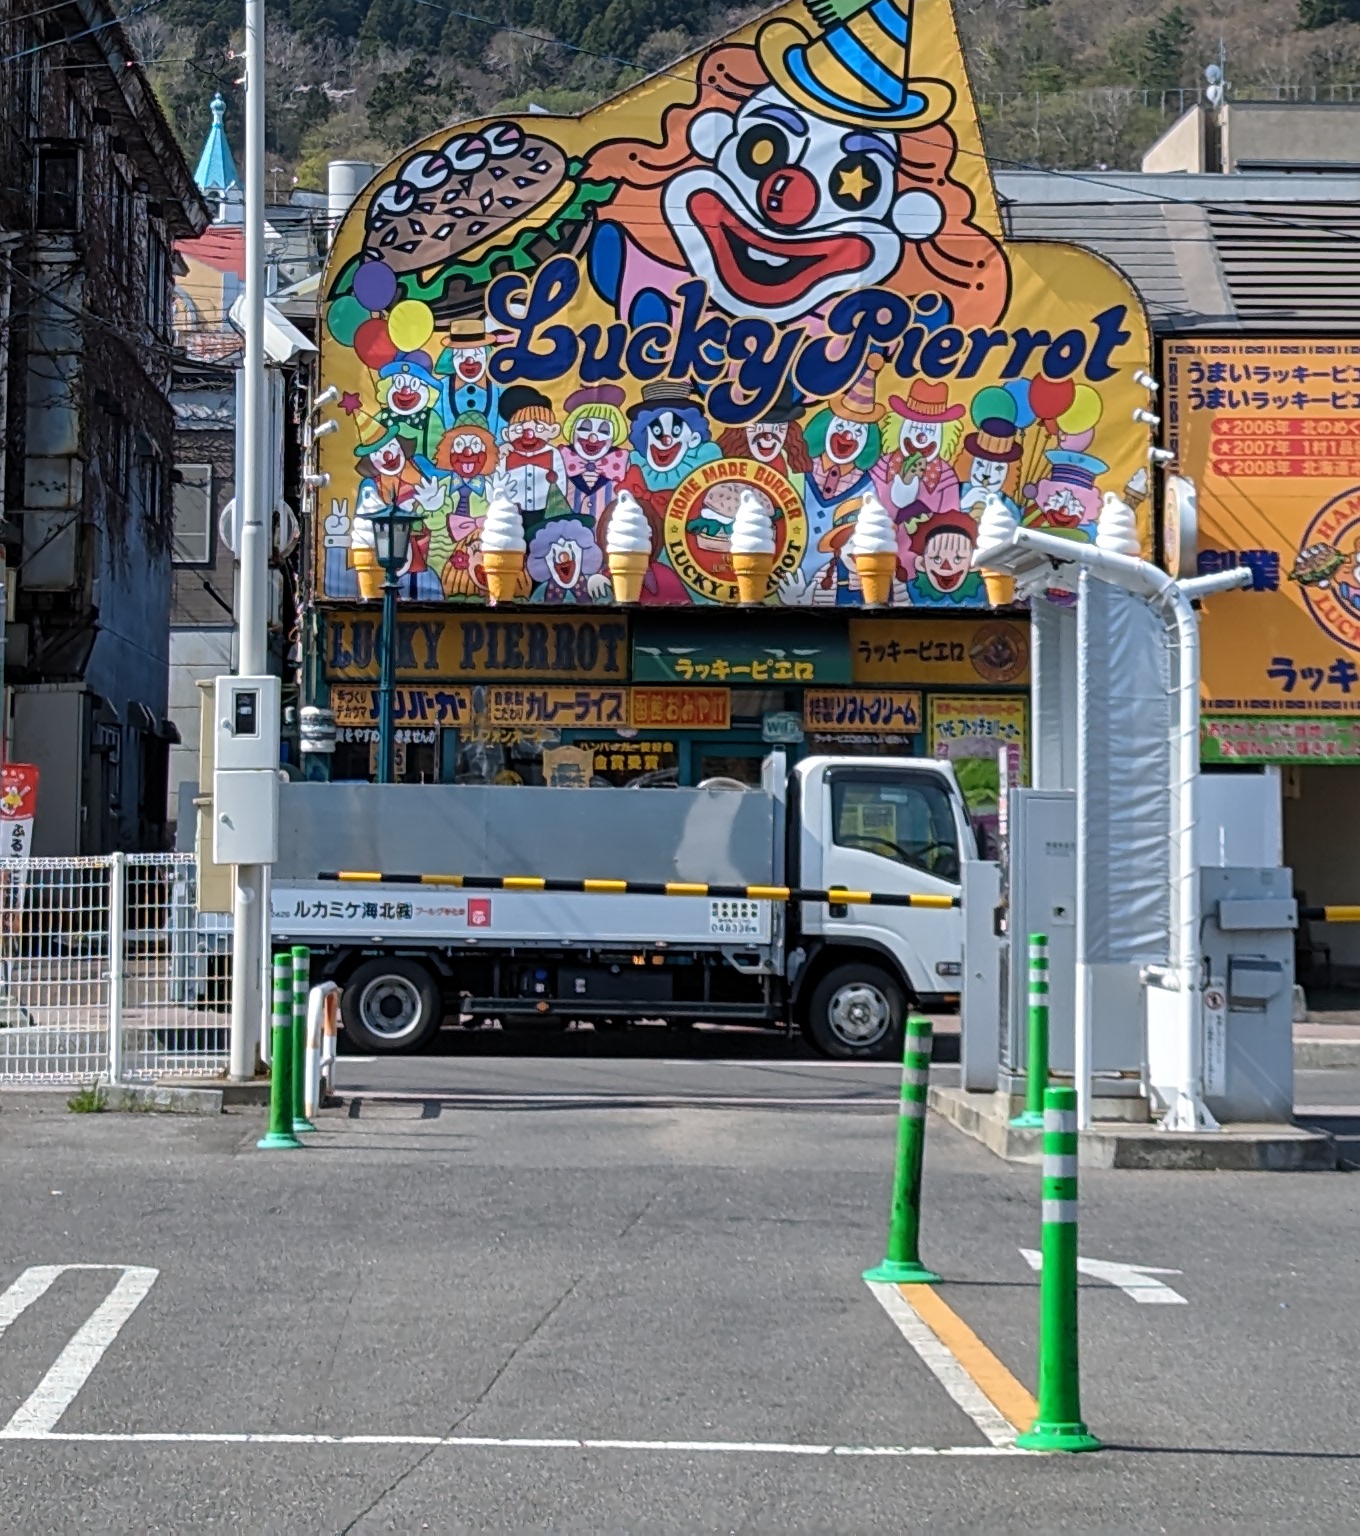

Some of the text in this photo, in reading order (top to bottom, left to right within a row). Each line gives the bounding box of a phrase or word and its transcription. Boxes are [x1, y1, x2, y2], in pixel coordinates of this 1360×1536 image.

[488, 254, 1131, 424] Lucky Pierrot
[1233, 421, 1291, 437] 2006年
[1233, 441, 1291, 457] 2007年
[668, 463, 803, 521] HOME MADE BURGER
[668, 539, 724, 596] LUCKY
[459, 621, 627, 672] PIERROT
[857, 639, 966, 664] ラッキーピエロ
[674, 657, 815, 681] ラッキーピエロ
[525, 690, 624, 722] カレーライス
